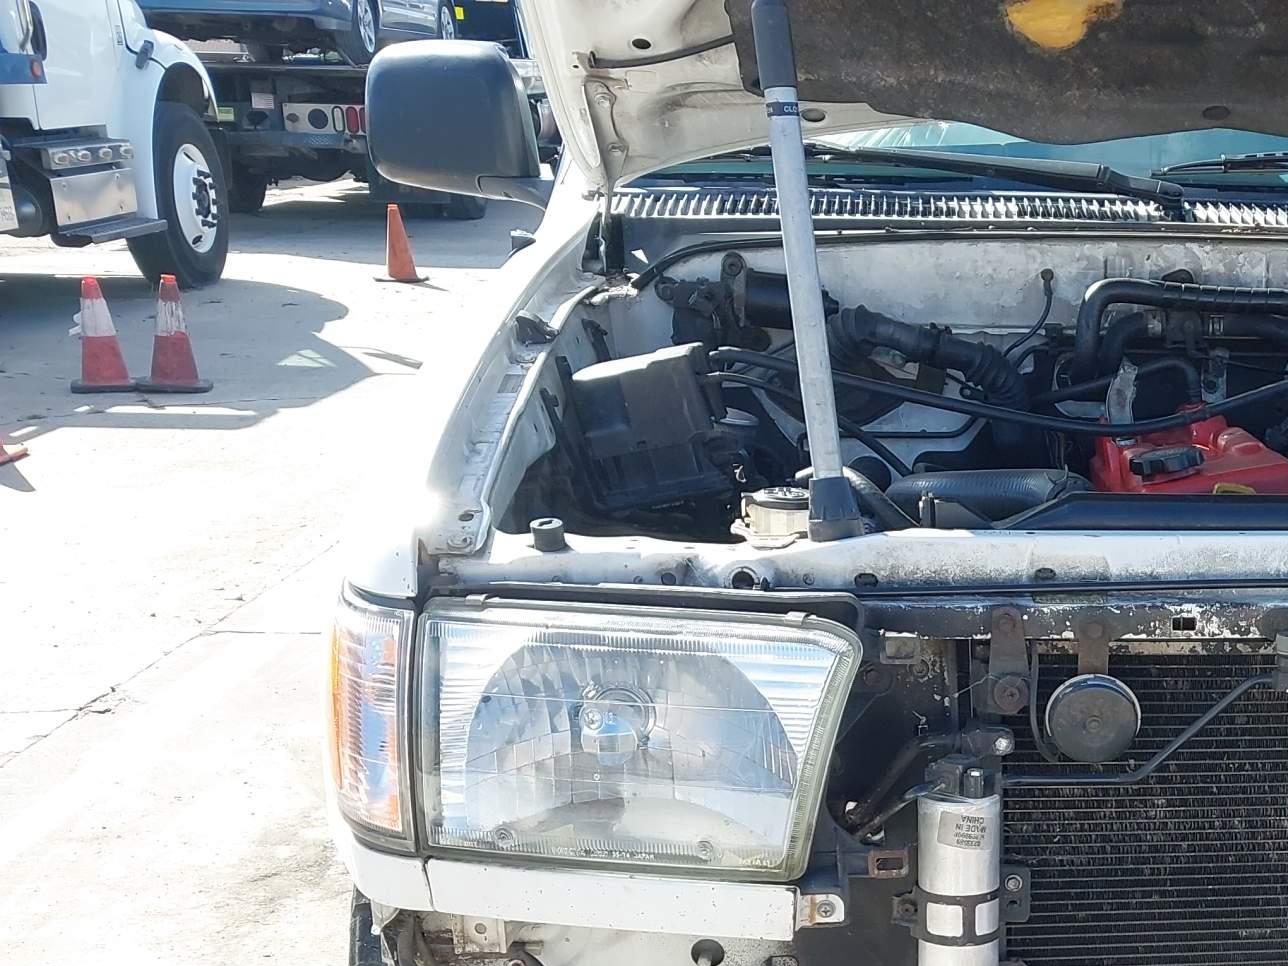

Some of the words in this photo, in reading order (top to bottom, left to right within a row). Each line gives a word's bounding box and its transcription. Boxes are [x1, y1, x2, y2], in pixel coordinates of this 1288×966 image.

[961, 815, 985, 825] CHINA
[955, 823, 964, 831] IN
[964, 824, 987, 833] MADE
